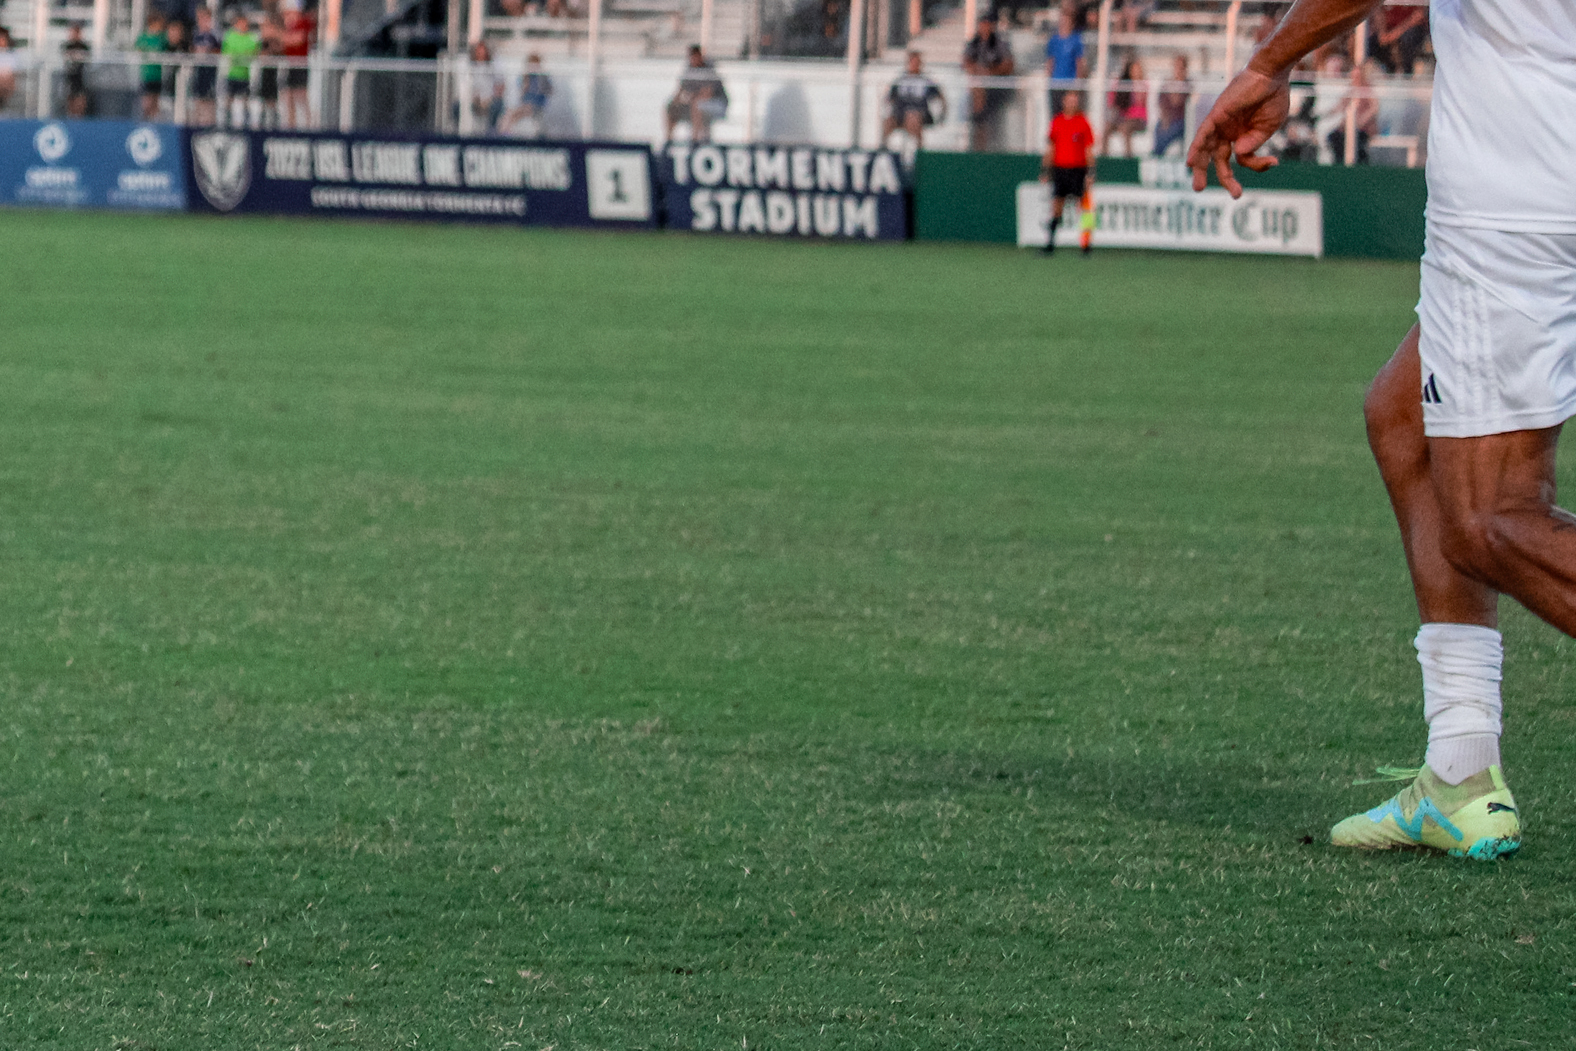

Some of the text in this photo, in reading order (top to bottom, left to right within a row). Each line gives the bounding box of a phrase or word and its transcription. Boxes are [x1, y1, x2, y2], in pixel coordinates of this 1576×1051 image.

[263, 139, 572, 191] 2022 USL LEAGUE ONE CHAMPIONS
[608, 168, 628, 203] 1
[668, 146, 901, 196] TORMENTA
[690, 188, 880, 239] STADIUM
[1232, 199, 1300, 245] Cup
